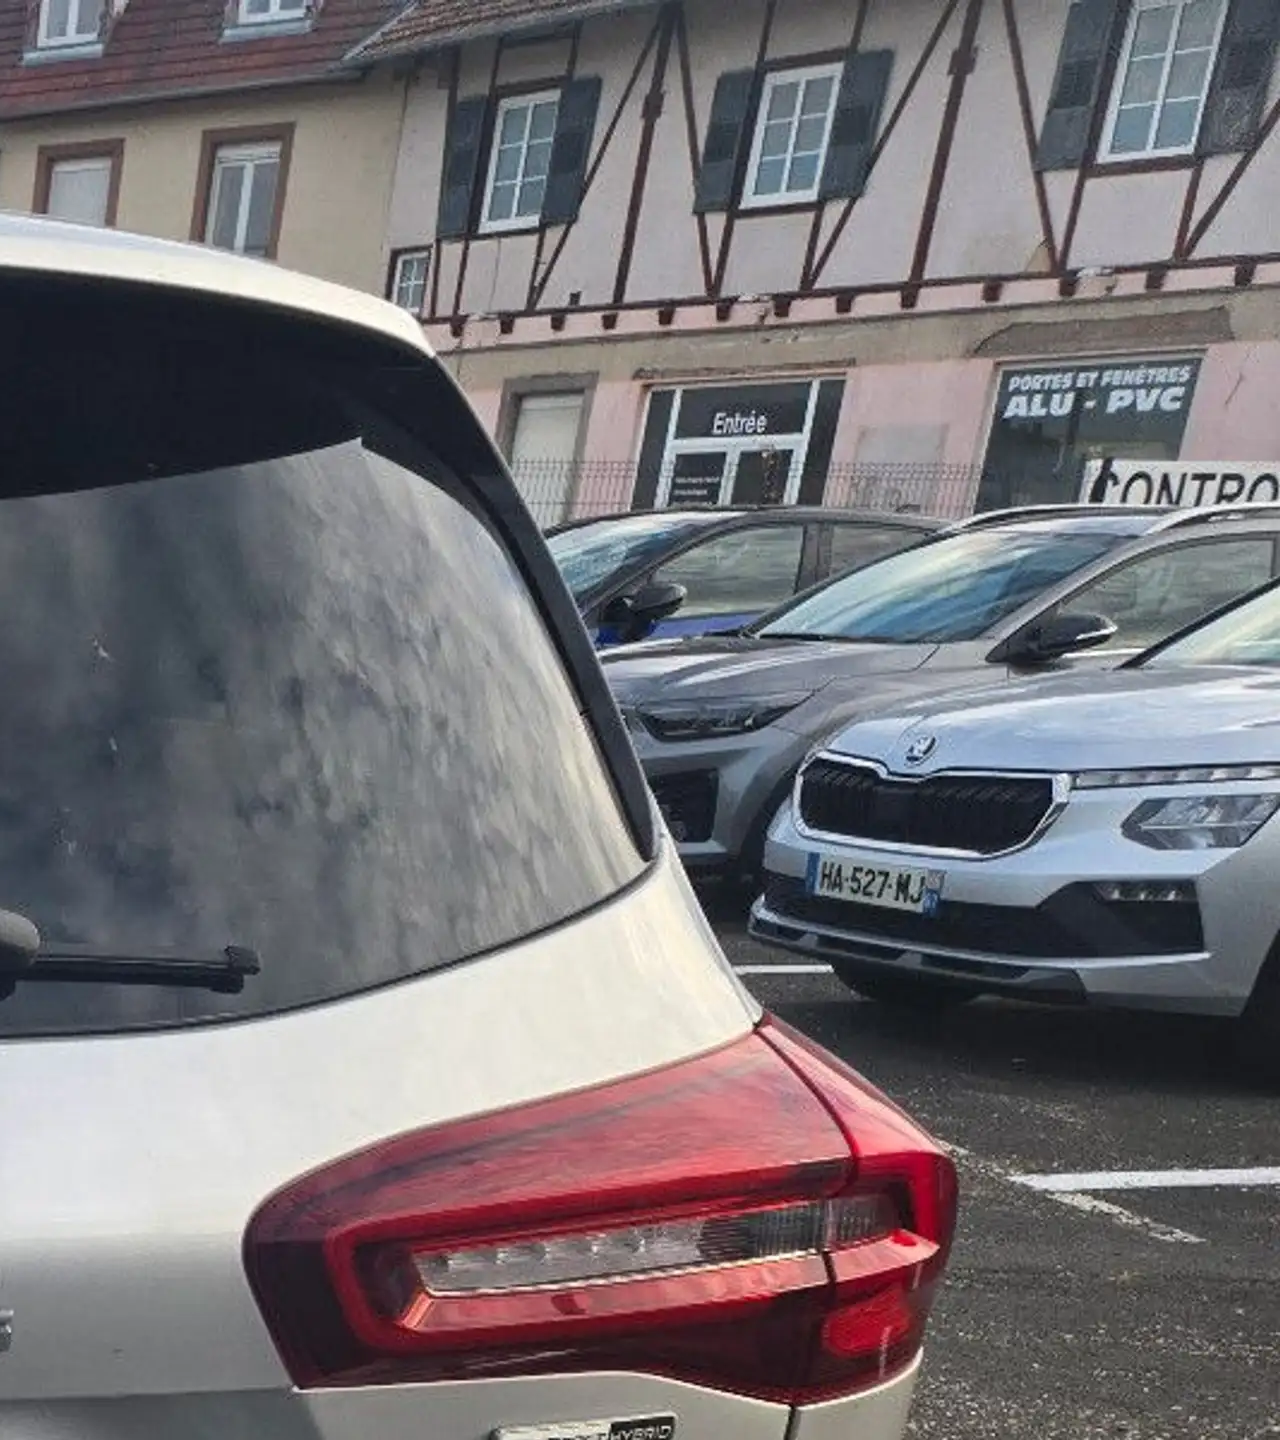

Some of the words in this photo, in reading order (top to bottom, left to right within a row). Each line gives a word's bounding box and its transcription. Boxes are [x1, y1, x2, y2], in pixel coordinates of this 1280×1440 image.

[1008, 373, 1074, 392] PORTES
[1075, 371, 1099, 388] ET
[1002, 391, 1076, 419] ALU
[1104, 386, 1186, 414] PVC
[712, 409, 768, 435] Entrée
